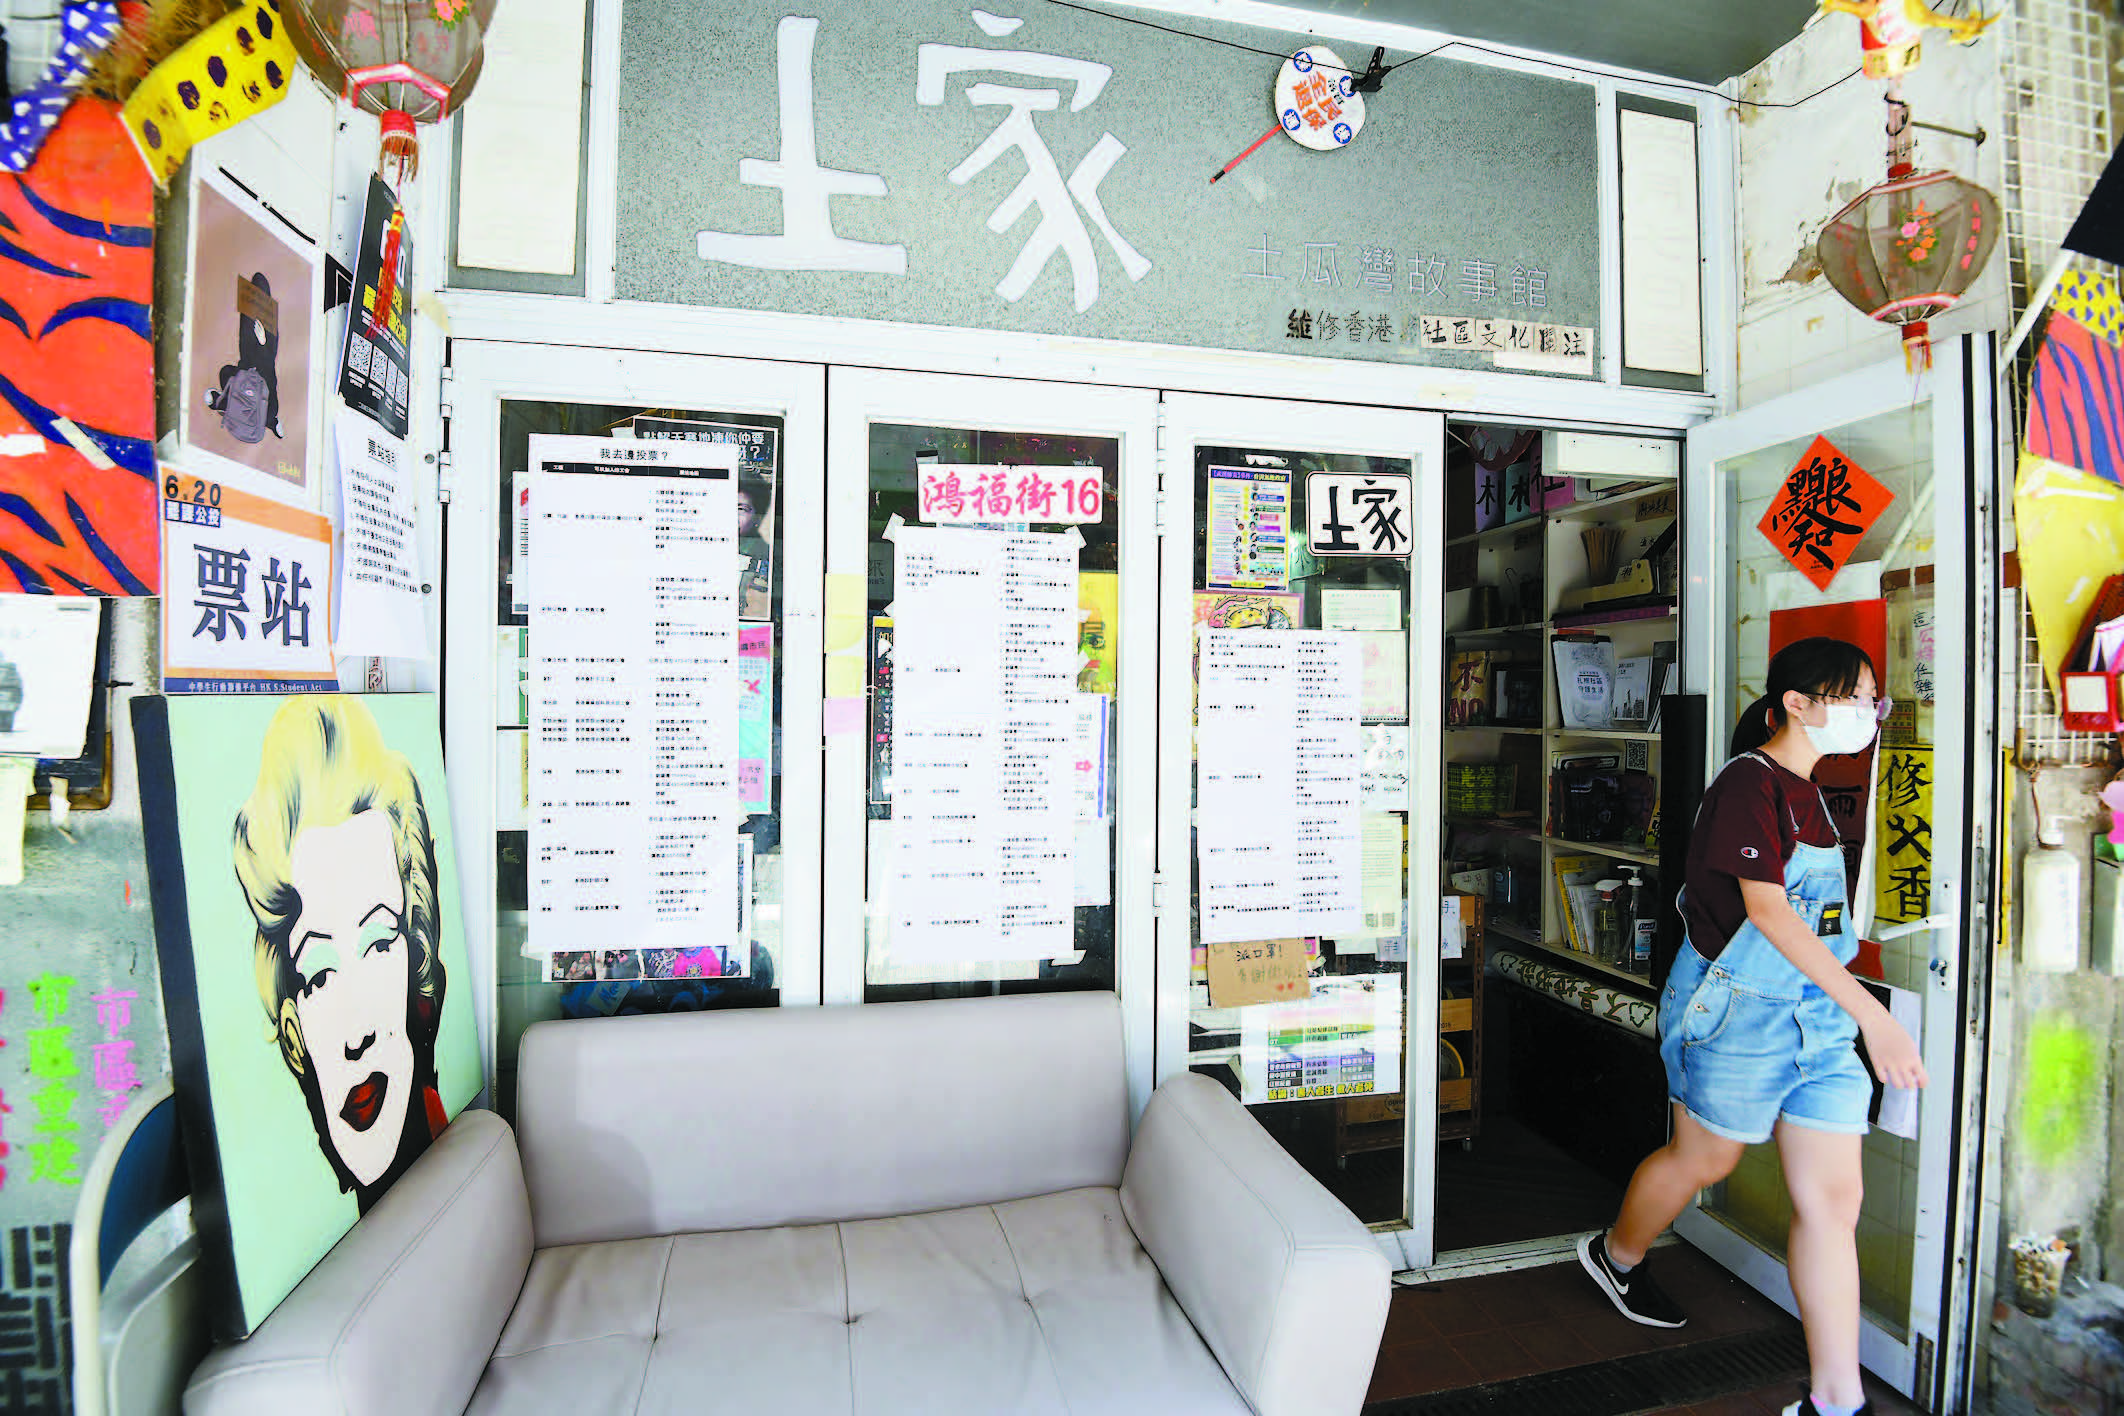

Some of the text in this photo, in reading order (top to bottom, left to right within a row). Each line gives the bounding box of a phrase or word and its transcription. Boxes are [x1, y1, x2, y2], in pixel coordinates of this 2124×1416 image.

[696, 9, 1152, 314] 土家
[1244, 233, 1549, 308] 土瓜灣故事館
[1286, 308, 1587, 355] 維修香港 社區文化關注
[165, 474, 221, 506] 6.20
[923, 472, 1100, 517] 鴻福街16
[1314, 480, 1408, 552] 土家
[193, 544, 312, 647] 票站
